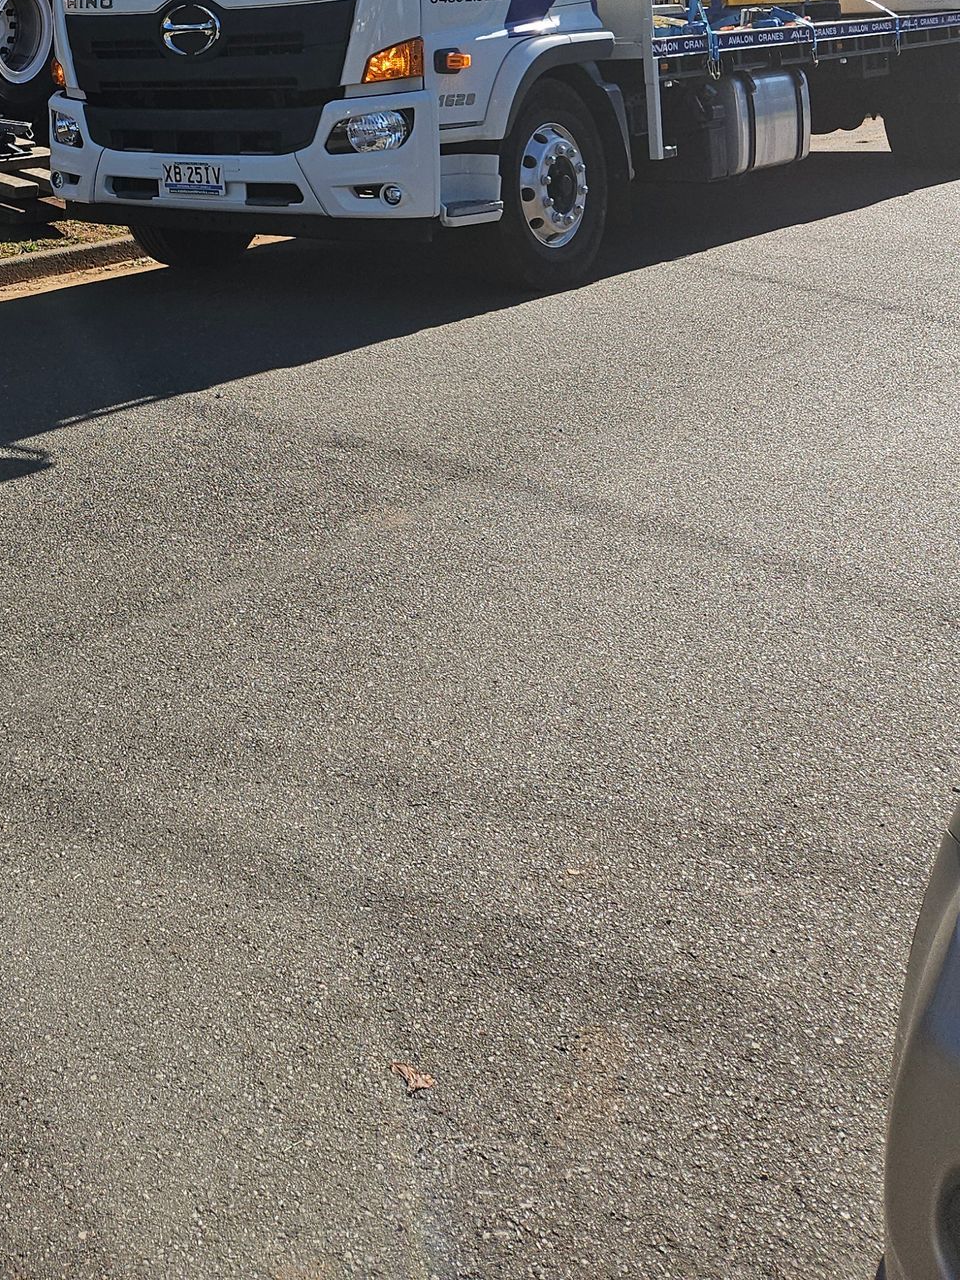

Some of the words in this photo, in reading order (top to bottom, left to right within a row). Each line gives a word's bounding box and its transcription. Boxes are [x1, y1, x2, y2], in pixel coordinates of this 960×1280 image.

[728, 34, 753, 45] AVALON
[758, 32, 784, 42] CRANES
[848, 24, 869, 33] AVALON
[871, 22, 892, 31] CRANES
